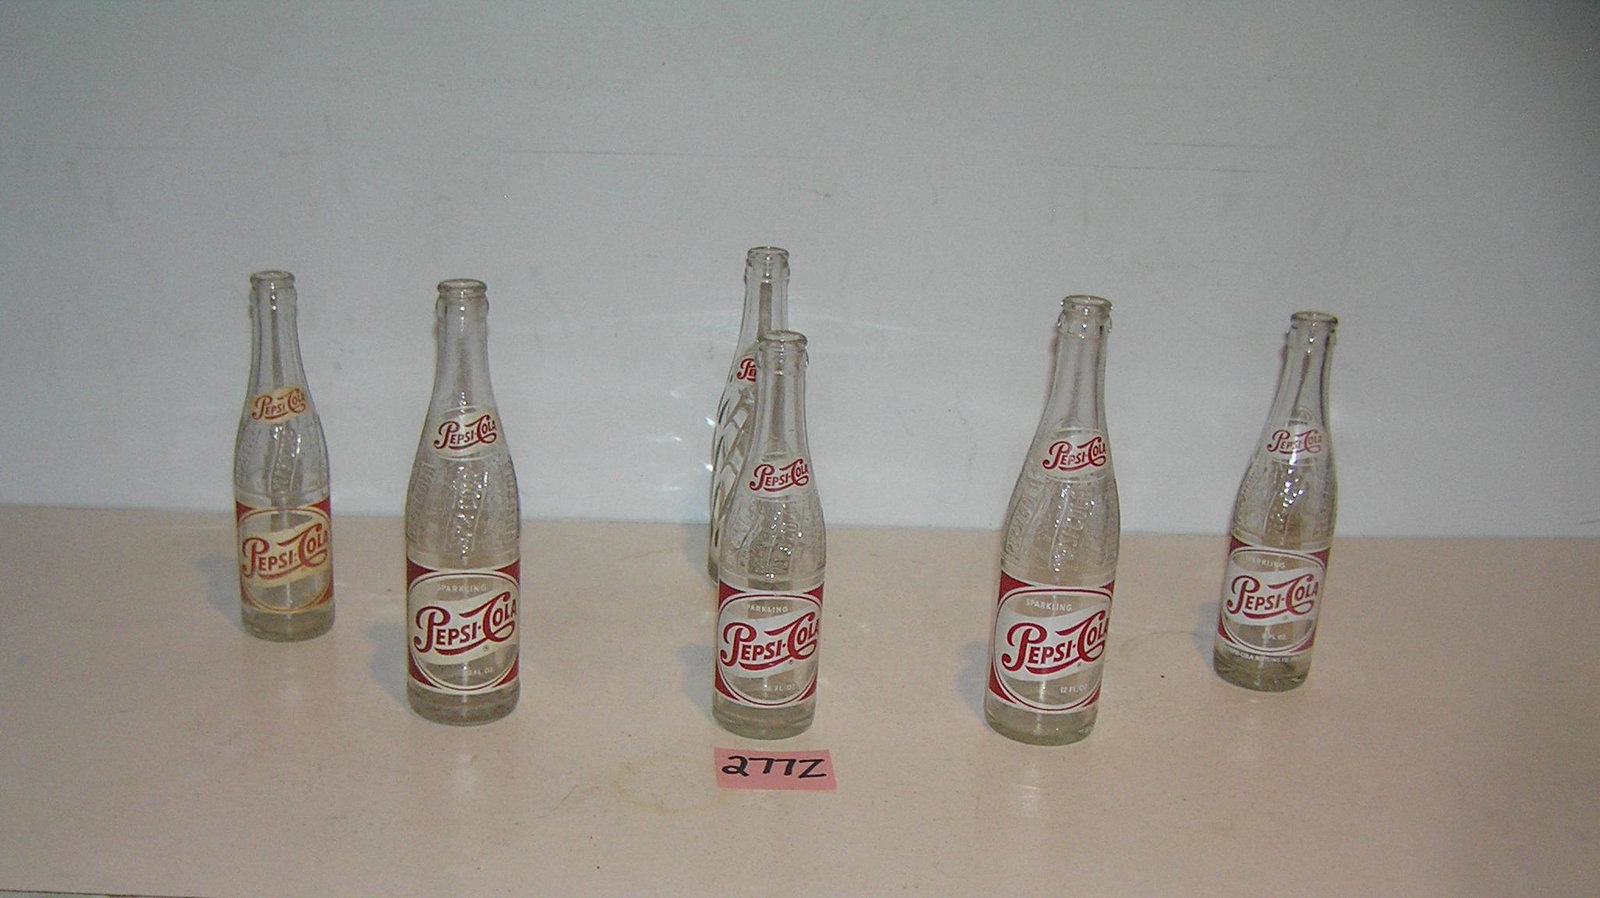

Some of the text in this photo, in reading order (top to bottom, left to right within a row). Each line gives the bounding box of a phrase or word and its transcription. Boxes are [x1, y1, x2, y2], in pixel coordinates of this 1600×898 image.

[433, 414, 497, 450] PEPSI-COLA
[1042, 436, 1106, 471] PEPSI-COLA
[749, 458, 810, 492] PEPSI-COLA
[1026, 599, 1072, 612] SPARKLING
[1226, 573, 1319, 619] PEPSI-COLA
[413, 591, 517, 656] PEPSI-COLA
[720, 611, 820, 671] PEPSI-COLA
[1001, 610, 1109, 675] PEPSI-COLA
